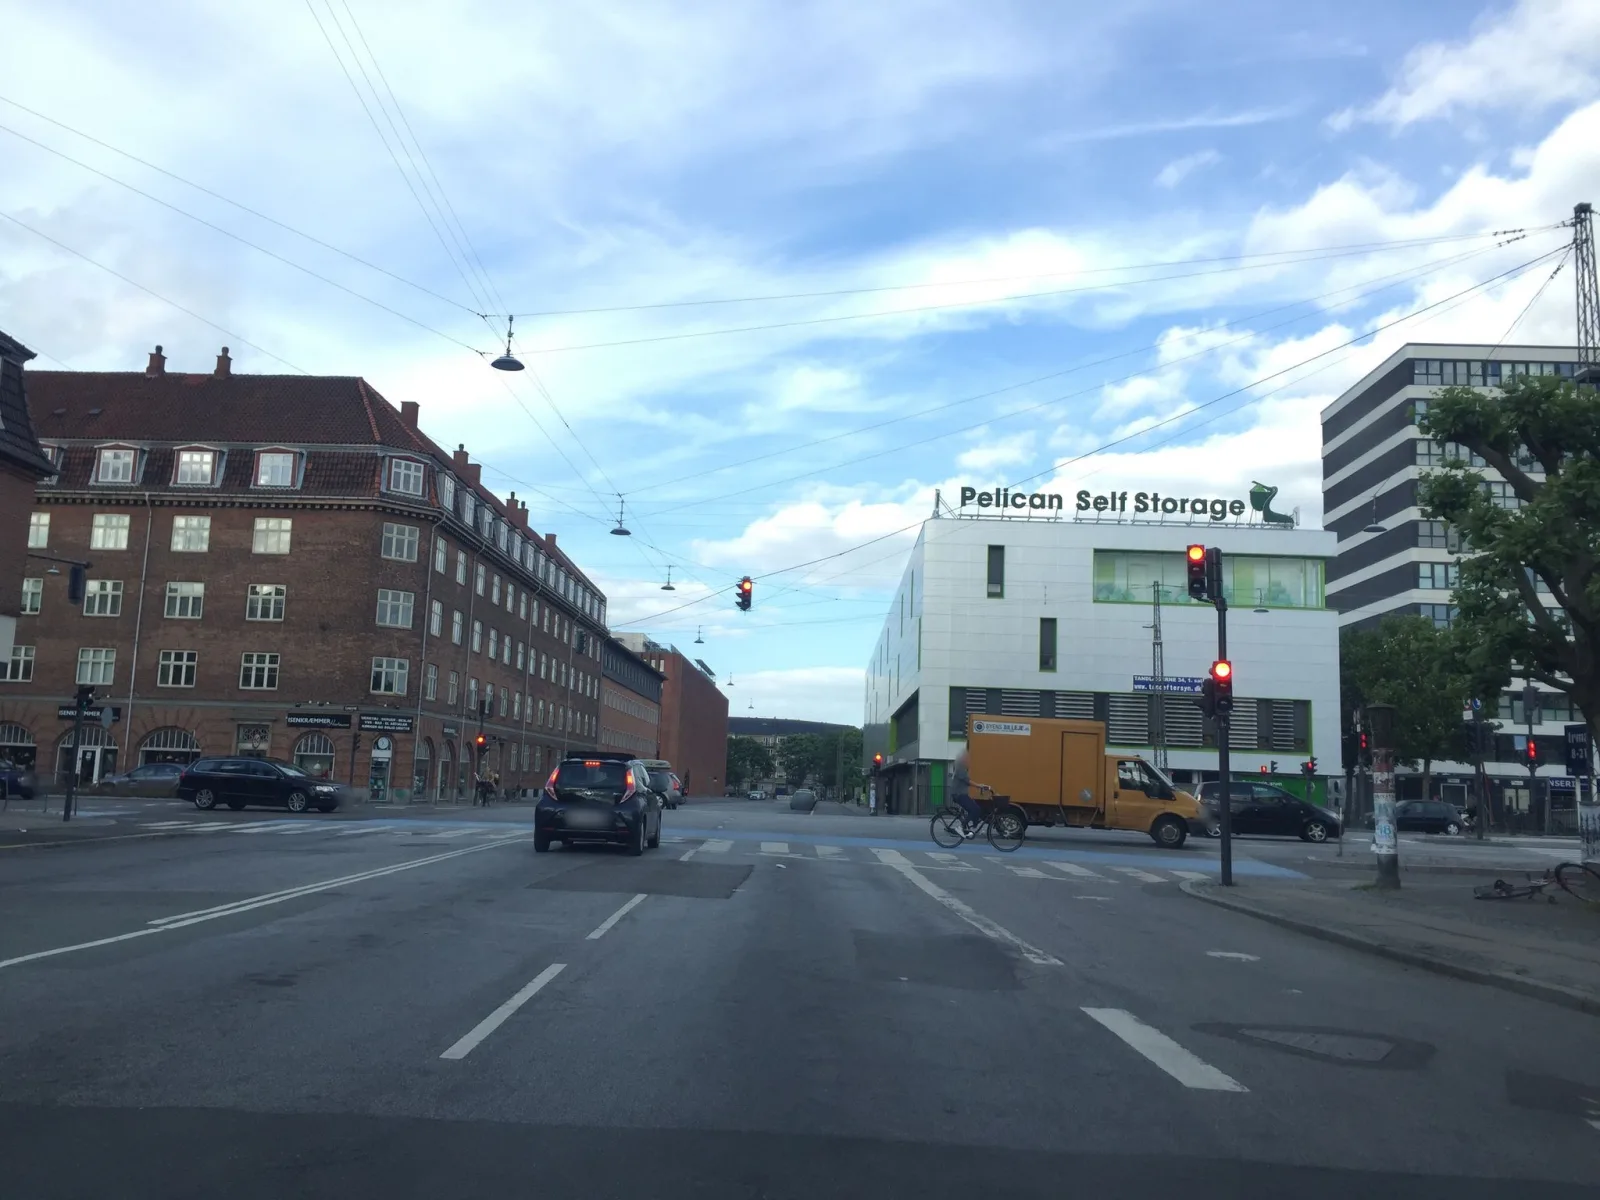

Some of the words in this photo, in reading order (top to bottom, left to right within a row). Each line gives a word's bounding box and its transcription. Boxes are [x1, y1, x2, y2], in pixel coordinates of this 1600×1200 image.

[961, 487, 1063, 509] Pelican
[1075, 490, 1128, 513] Self
[1134, 492, 1246, 521] Storage
